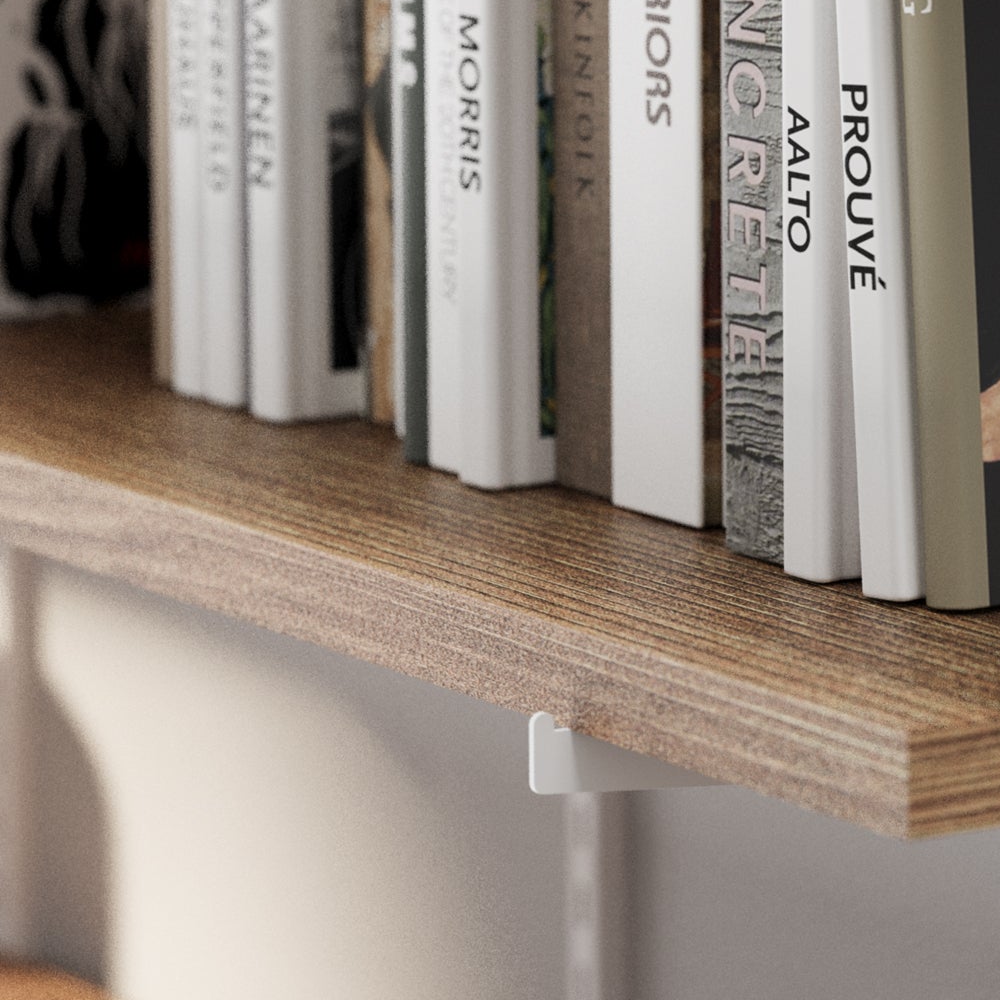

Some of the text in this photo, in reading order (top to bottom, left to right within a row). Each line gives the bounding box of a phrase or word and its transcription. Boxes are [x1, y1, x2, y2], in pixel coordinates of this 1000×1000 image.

[458, 13, 481, 192] MORRIS
[574, 0, 595, 201] KINFOLK
[786, 105, 812, 253] AALTO
[841, 84, 887, 291] PROUVÉ
